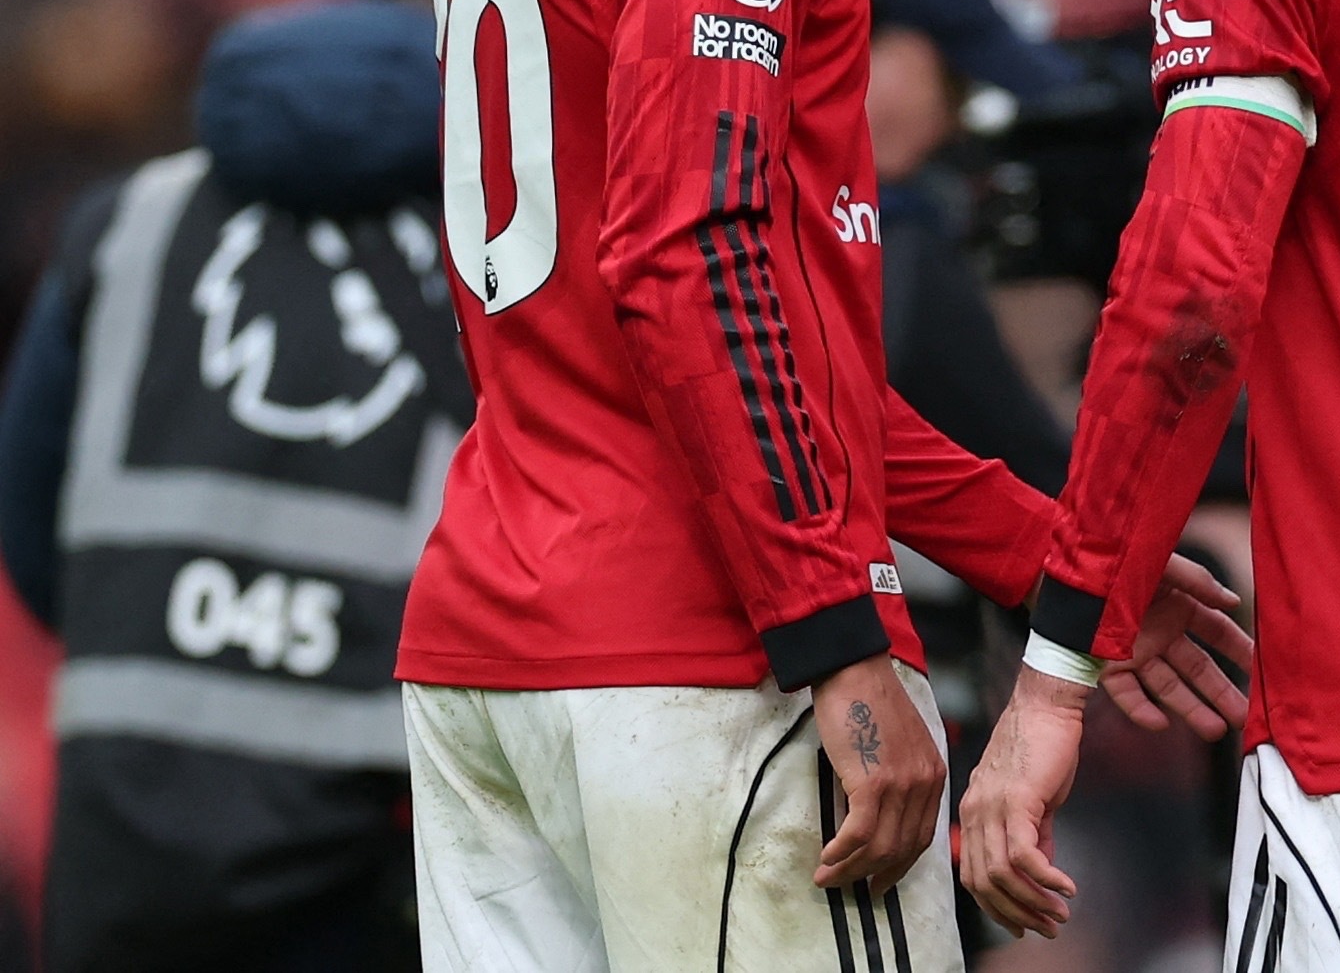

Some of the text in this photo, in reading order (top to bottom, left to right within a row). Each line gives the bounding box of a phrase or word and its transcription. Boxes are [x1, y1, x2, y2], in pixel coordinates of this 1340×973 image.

[693, 34, 779, 77] for racism
[694, 14, 778, 54] No room
[832, 185, 881, 247] Sn
[165, 556, 343, 677] 045
